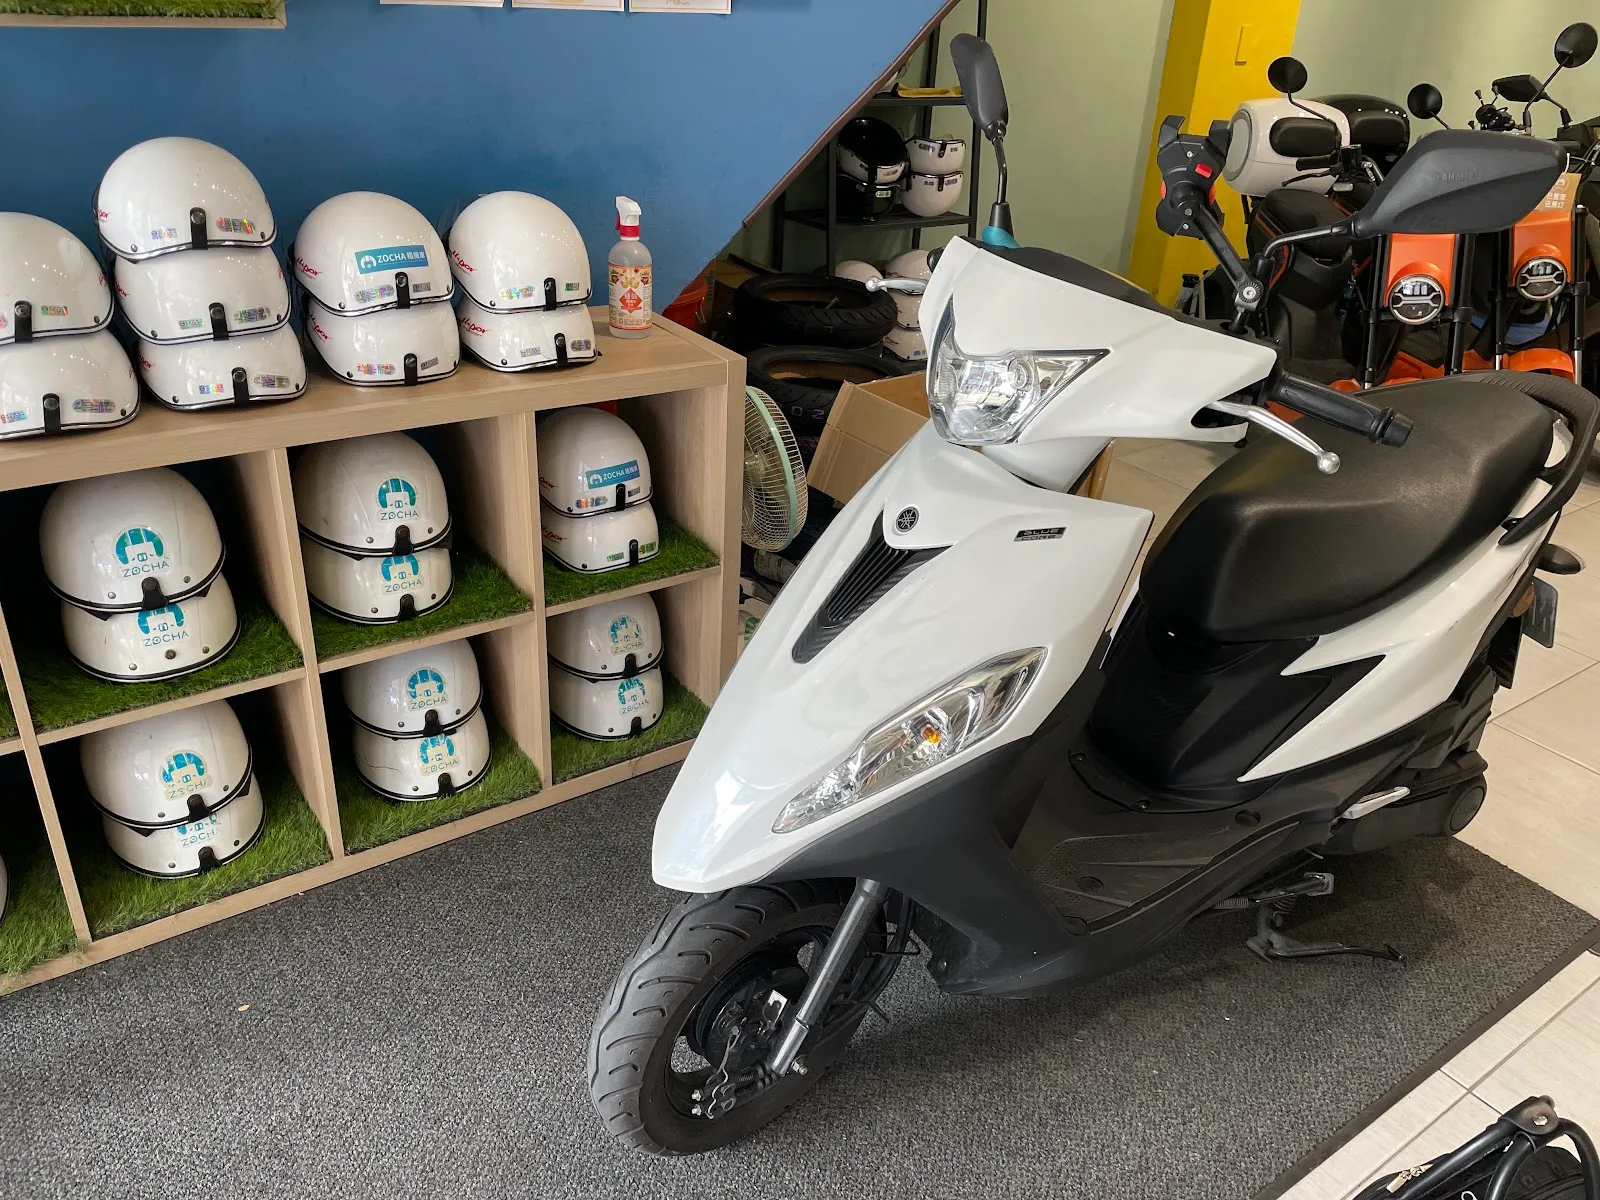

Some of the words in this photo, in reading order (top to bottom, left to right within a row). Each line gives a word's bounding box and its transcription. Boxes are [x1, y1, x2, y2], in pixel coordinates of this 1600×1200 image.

[377, 252, 406, 263] ZOCHA
[603, 469, 625, 480] ZOCHA
[381, 511, 419, 521] ZOCHA
[123, 562, 170, 578] ZOCHA
[385, 580, 423, 593] ZOCHA
[144, 631, 190, 647] ZOCHA
[411, 697, 447, 709] ZOCHA
[621, 699, 650, 714] ZOCHA
[424, 760, 459, 774] ZOCHA
